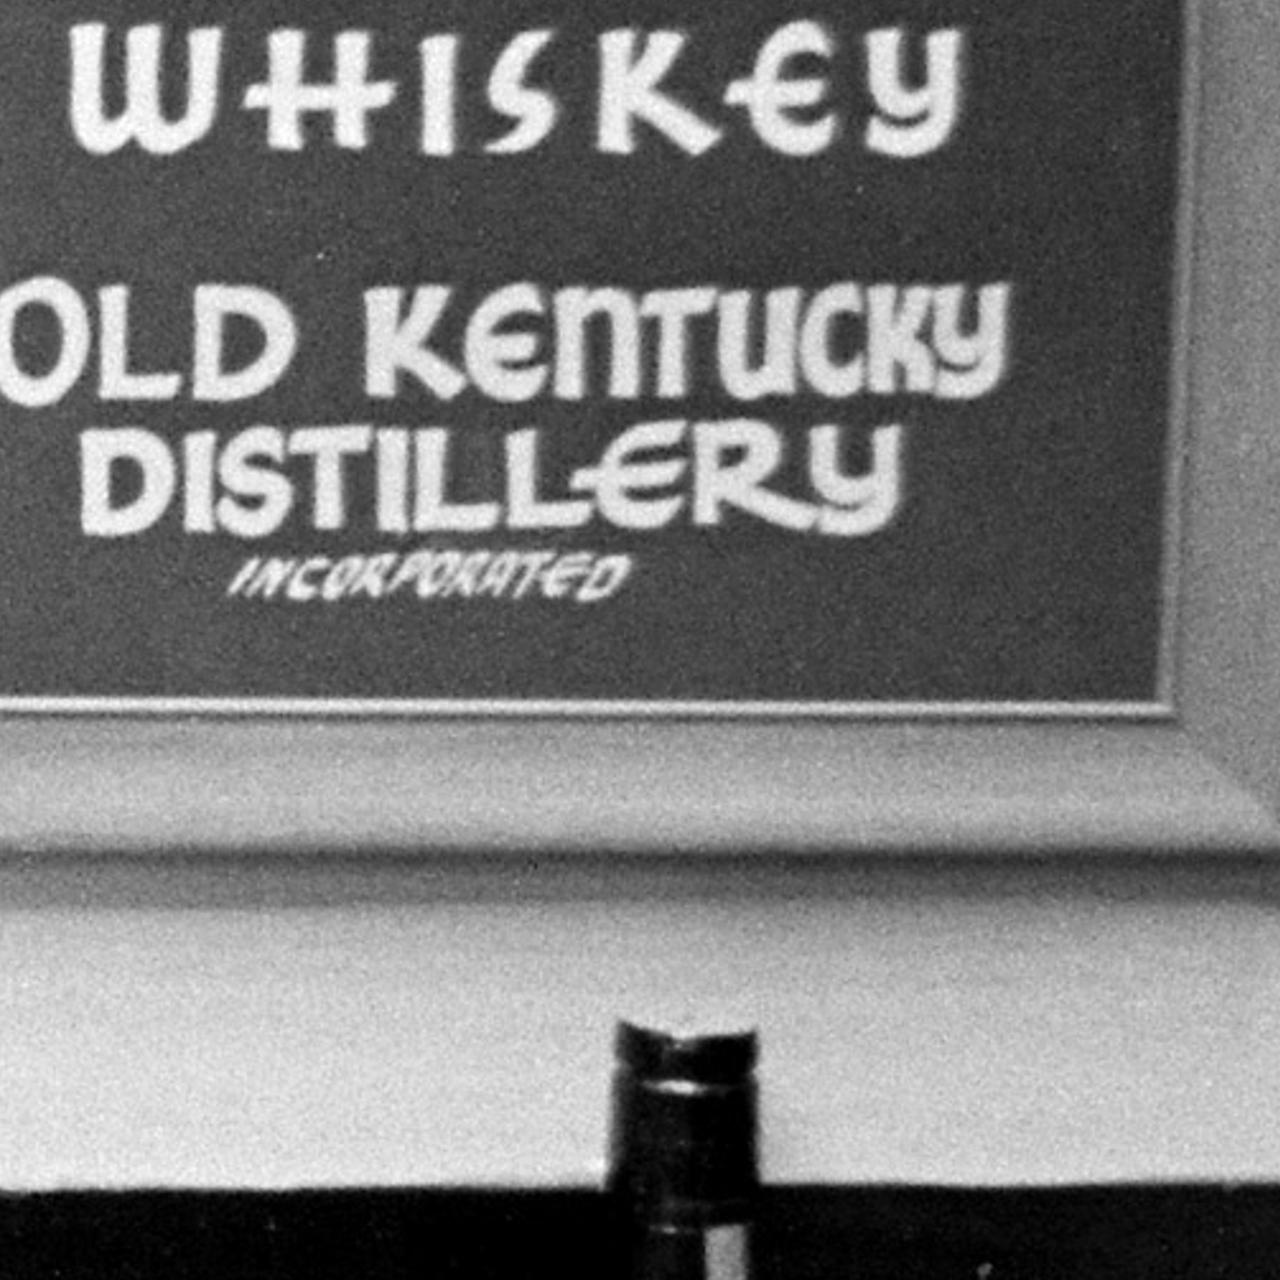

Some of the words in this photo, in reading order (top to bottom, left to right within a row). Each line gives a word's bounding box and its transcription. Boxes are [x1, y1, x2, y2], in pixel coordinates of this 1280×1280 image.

[68, 20, 962, 158] WHISKEY
[363, 282, 1009, 401] KENTUCKY
[78, 418, 902, 539] DISTILLERY
[224, 549, 634, 603] INCORPORATED
